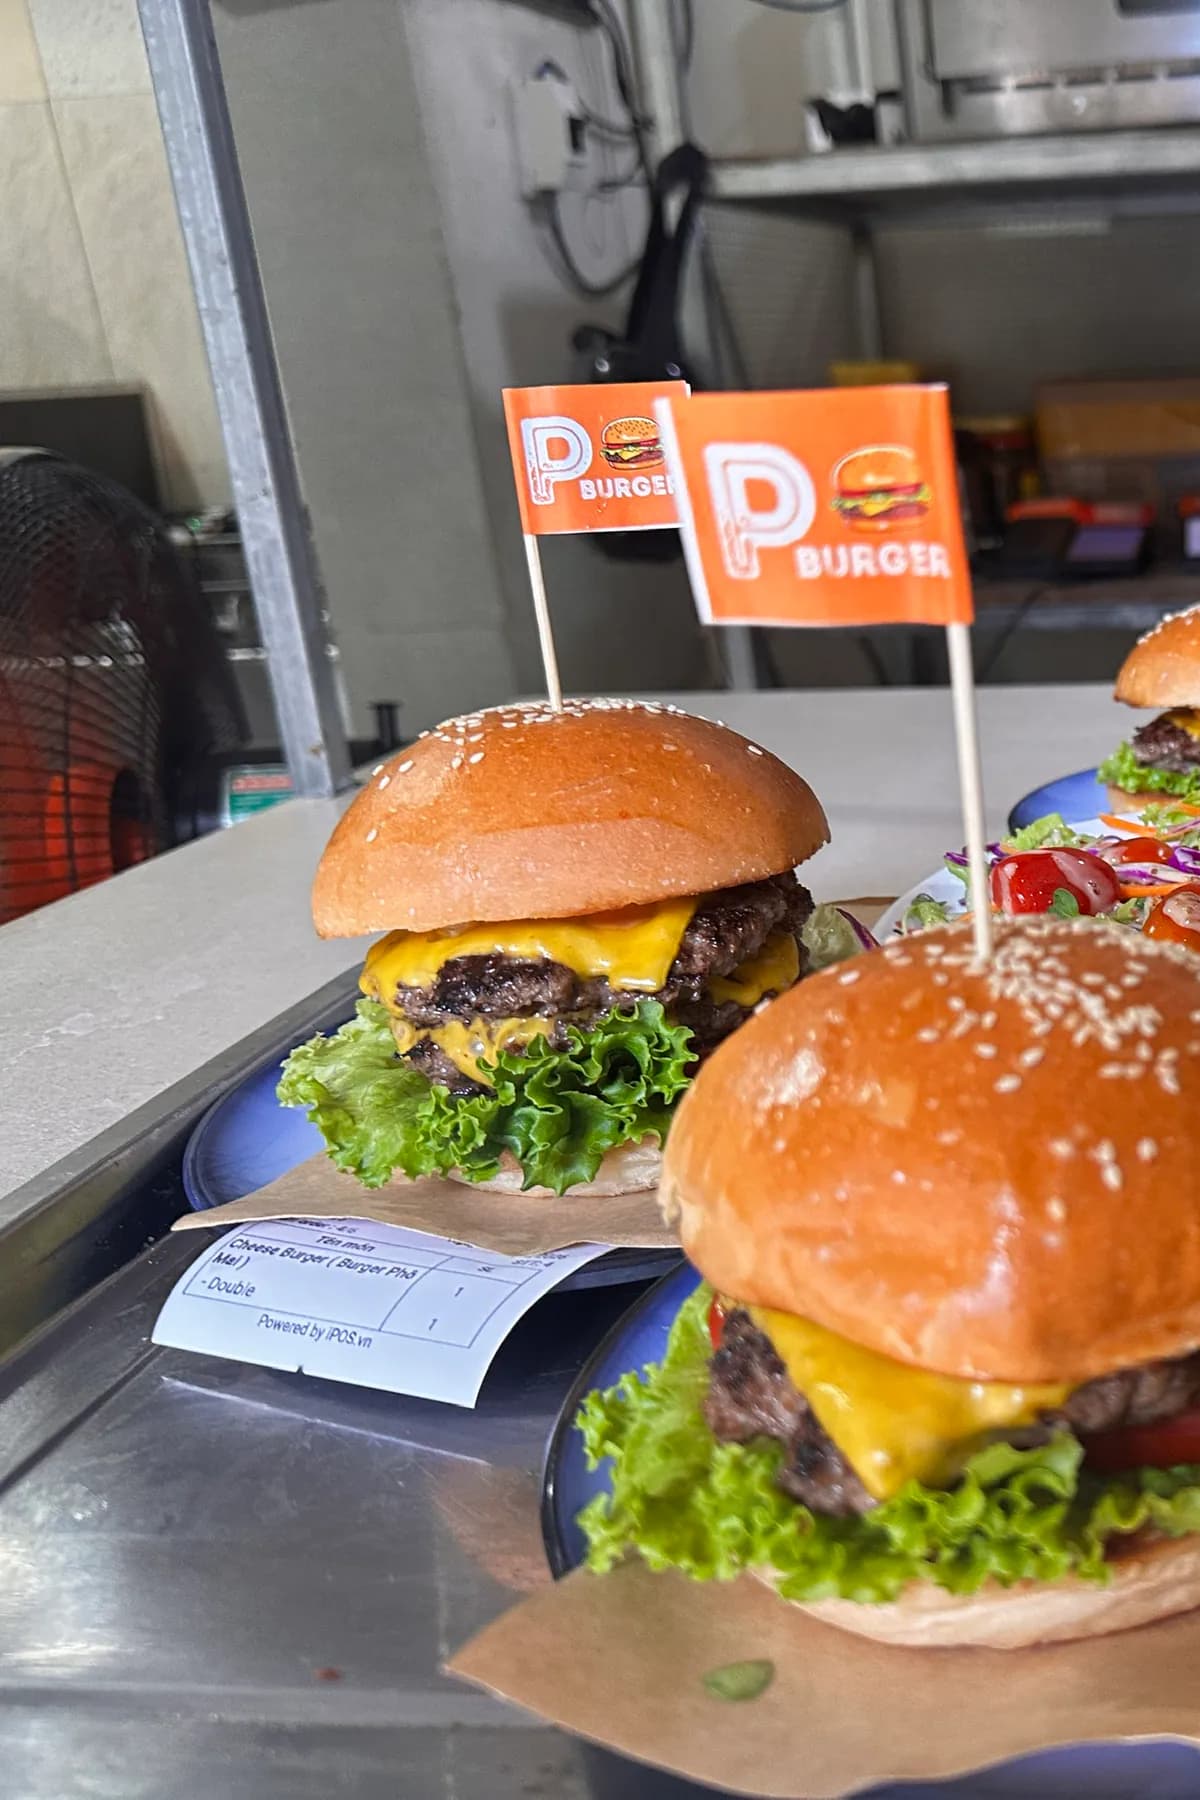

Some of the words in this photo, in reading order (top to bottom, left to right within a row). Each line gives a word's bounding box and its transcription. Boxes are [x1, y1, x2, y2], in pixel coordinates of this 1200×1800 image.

[520, 416, 593, 506] P
[704, 443, 817, 580] P
[794, 543, 953, 580] BURGER
[229, 1237, 279, 1256] Cheese
[279, 1247, 330, 1265] Burger
[336, 1257, 387, 1275] Burger
[207, 1276, 256, 1298] Double
[257, 1313, 310, 1336] Powered
[309, 1322, 326, 1342] by
